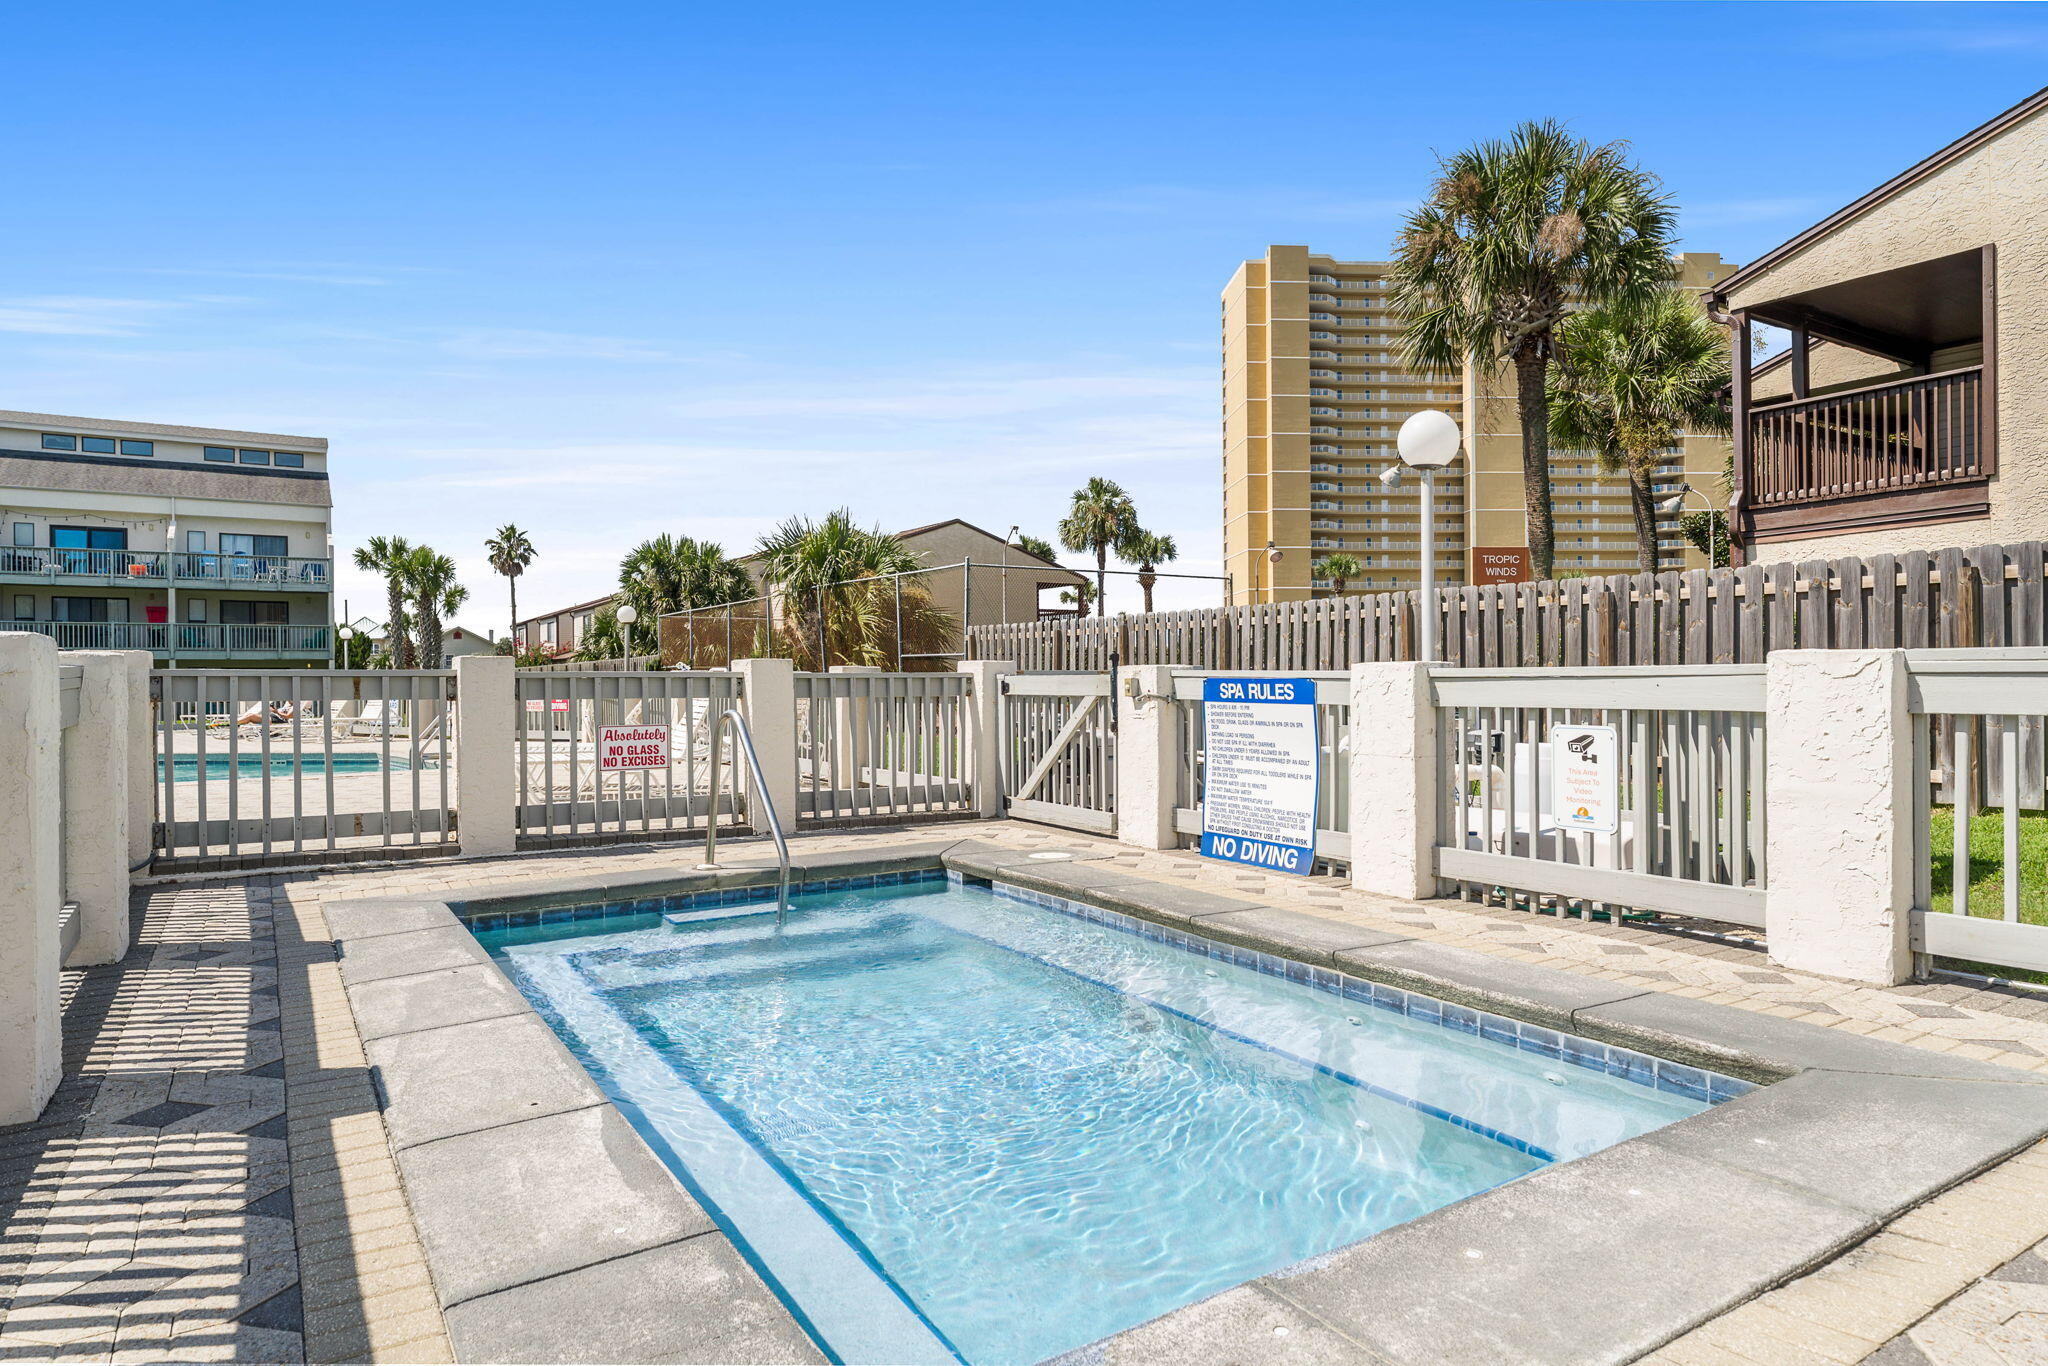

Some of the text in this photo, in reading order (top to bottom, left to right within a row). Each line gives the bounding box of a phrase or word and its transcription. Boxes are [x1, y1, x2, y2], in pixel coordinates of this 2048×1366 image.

[1482, 555, 1520, 564] TROPIC
[1486, 568, 1517, 576] WINDS
[1220, 682, 1294, 700] SPA RULES
[603, 728, 666, 742] Absolutely
[609, 744, 660, 756] NO GLASS
[603, 755, 666, 768] NO EXCUSES
[1574, 786, 1592, 794] Video
[1239, 796, 1262, 804] TEMPERATURE
[1566, 796, 1600, 806] Monitoring
[1216, 826, 1240, 834] LIFEGUARD
[1212, 836, 1299, 870] NO DIVING
